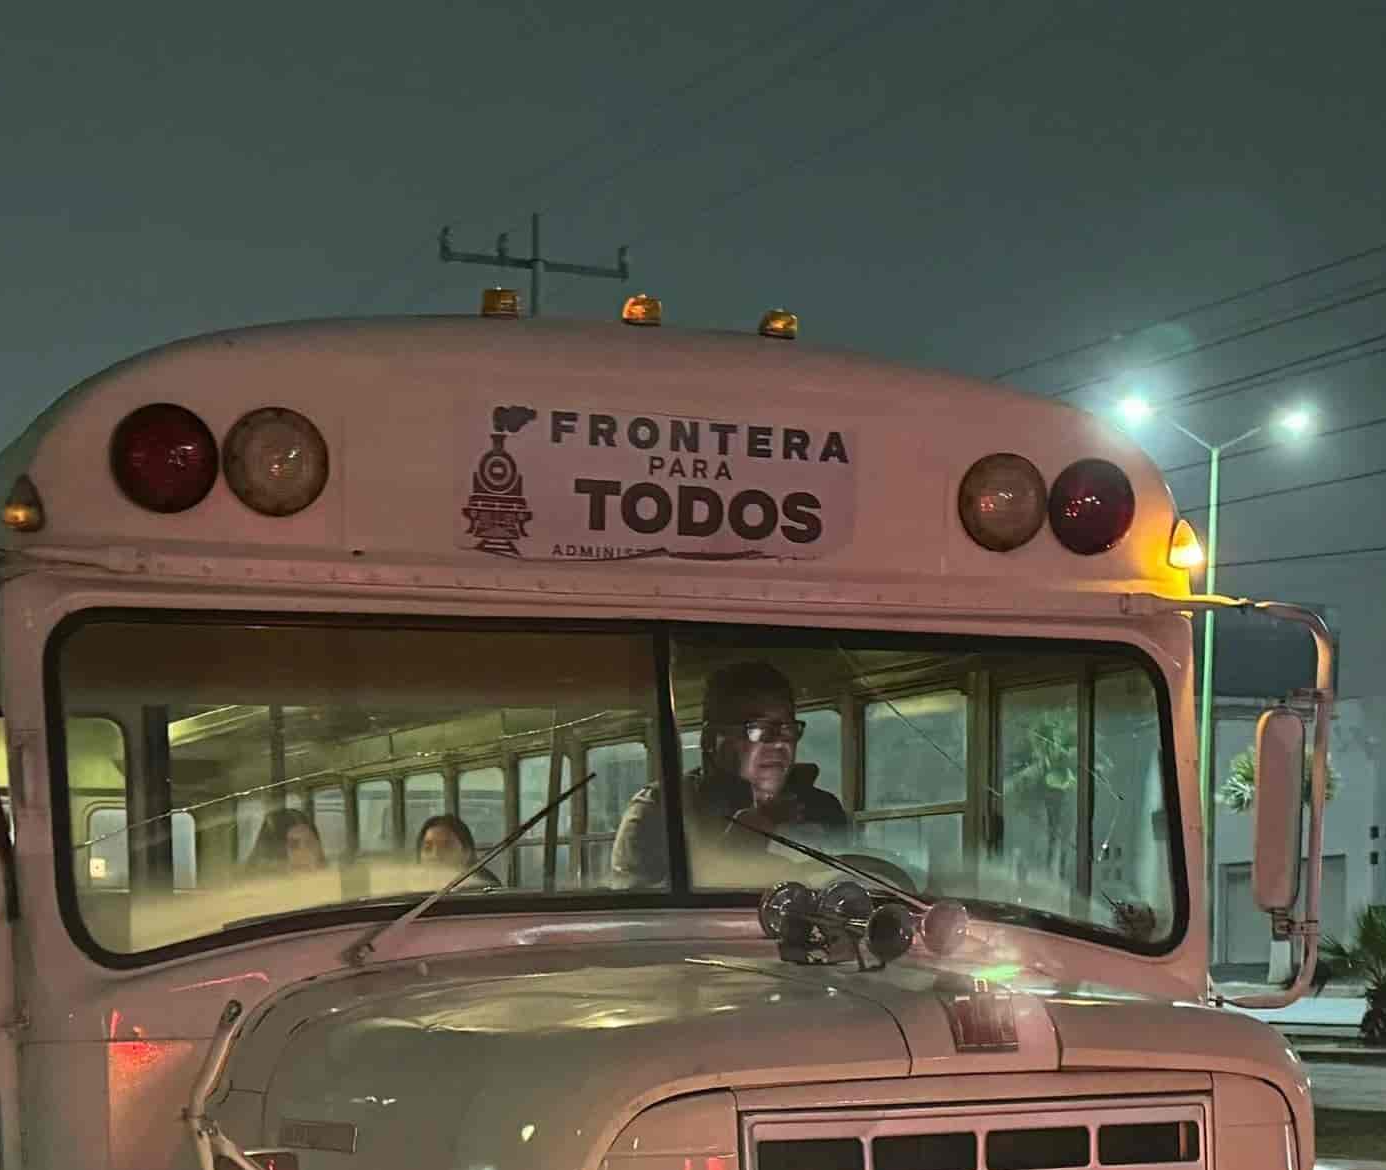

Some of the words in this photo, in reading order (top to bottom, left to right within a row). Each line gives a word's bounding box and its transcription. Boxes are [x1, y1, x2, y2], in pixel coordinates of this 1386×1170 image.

[550, 410, 850, 464] FRONTERA
[648, 456, 733, 480] PARA
[575, 478, 823, 544] TODOS
